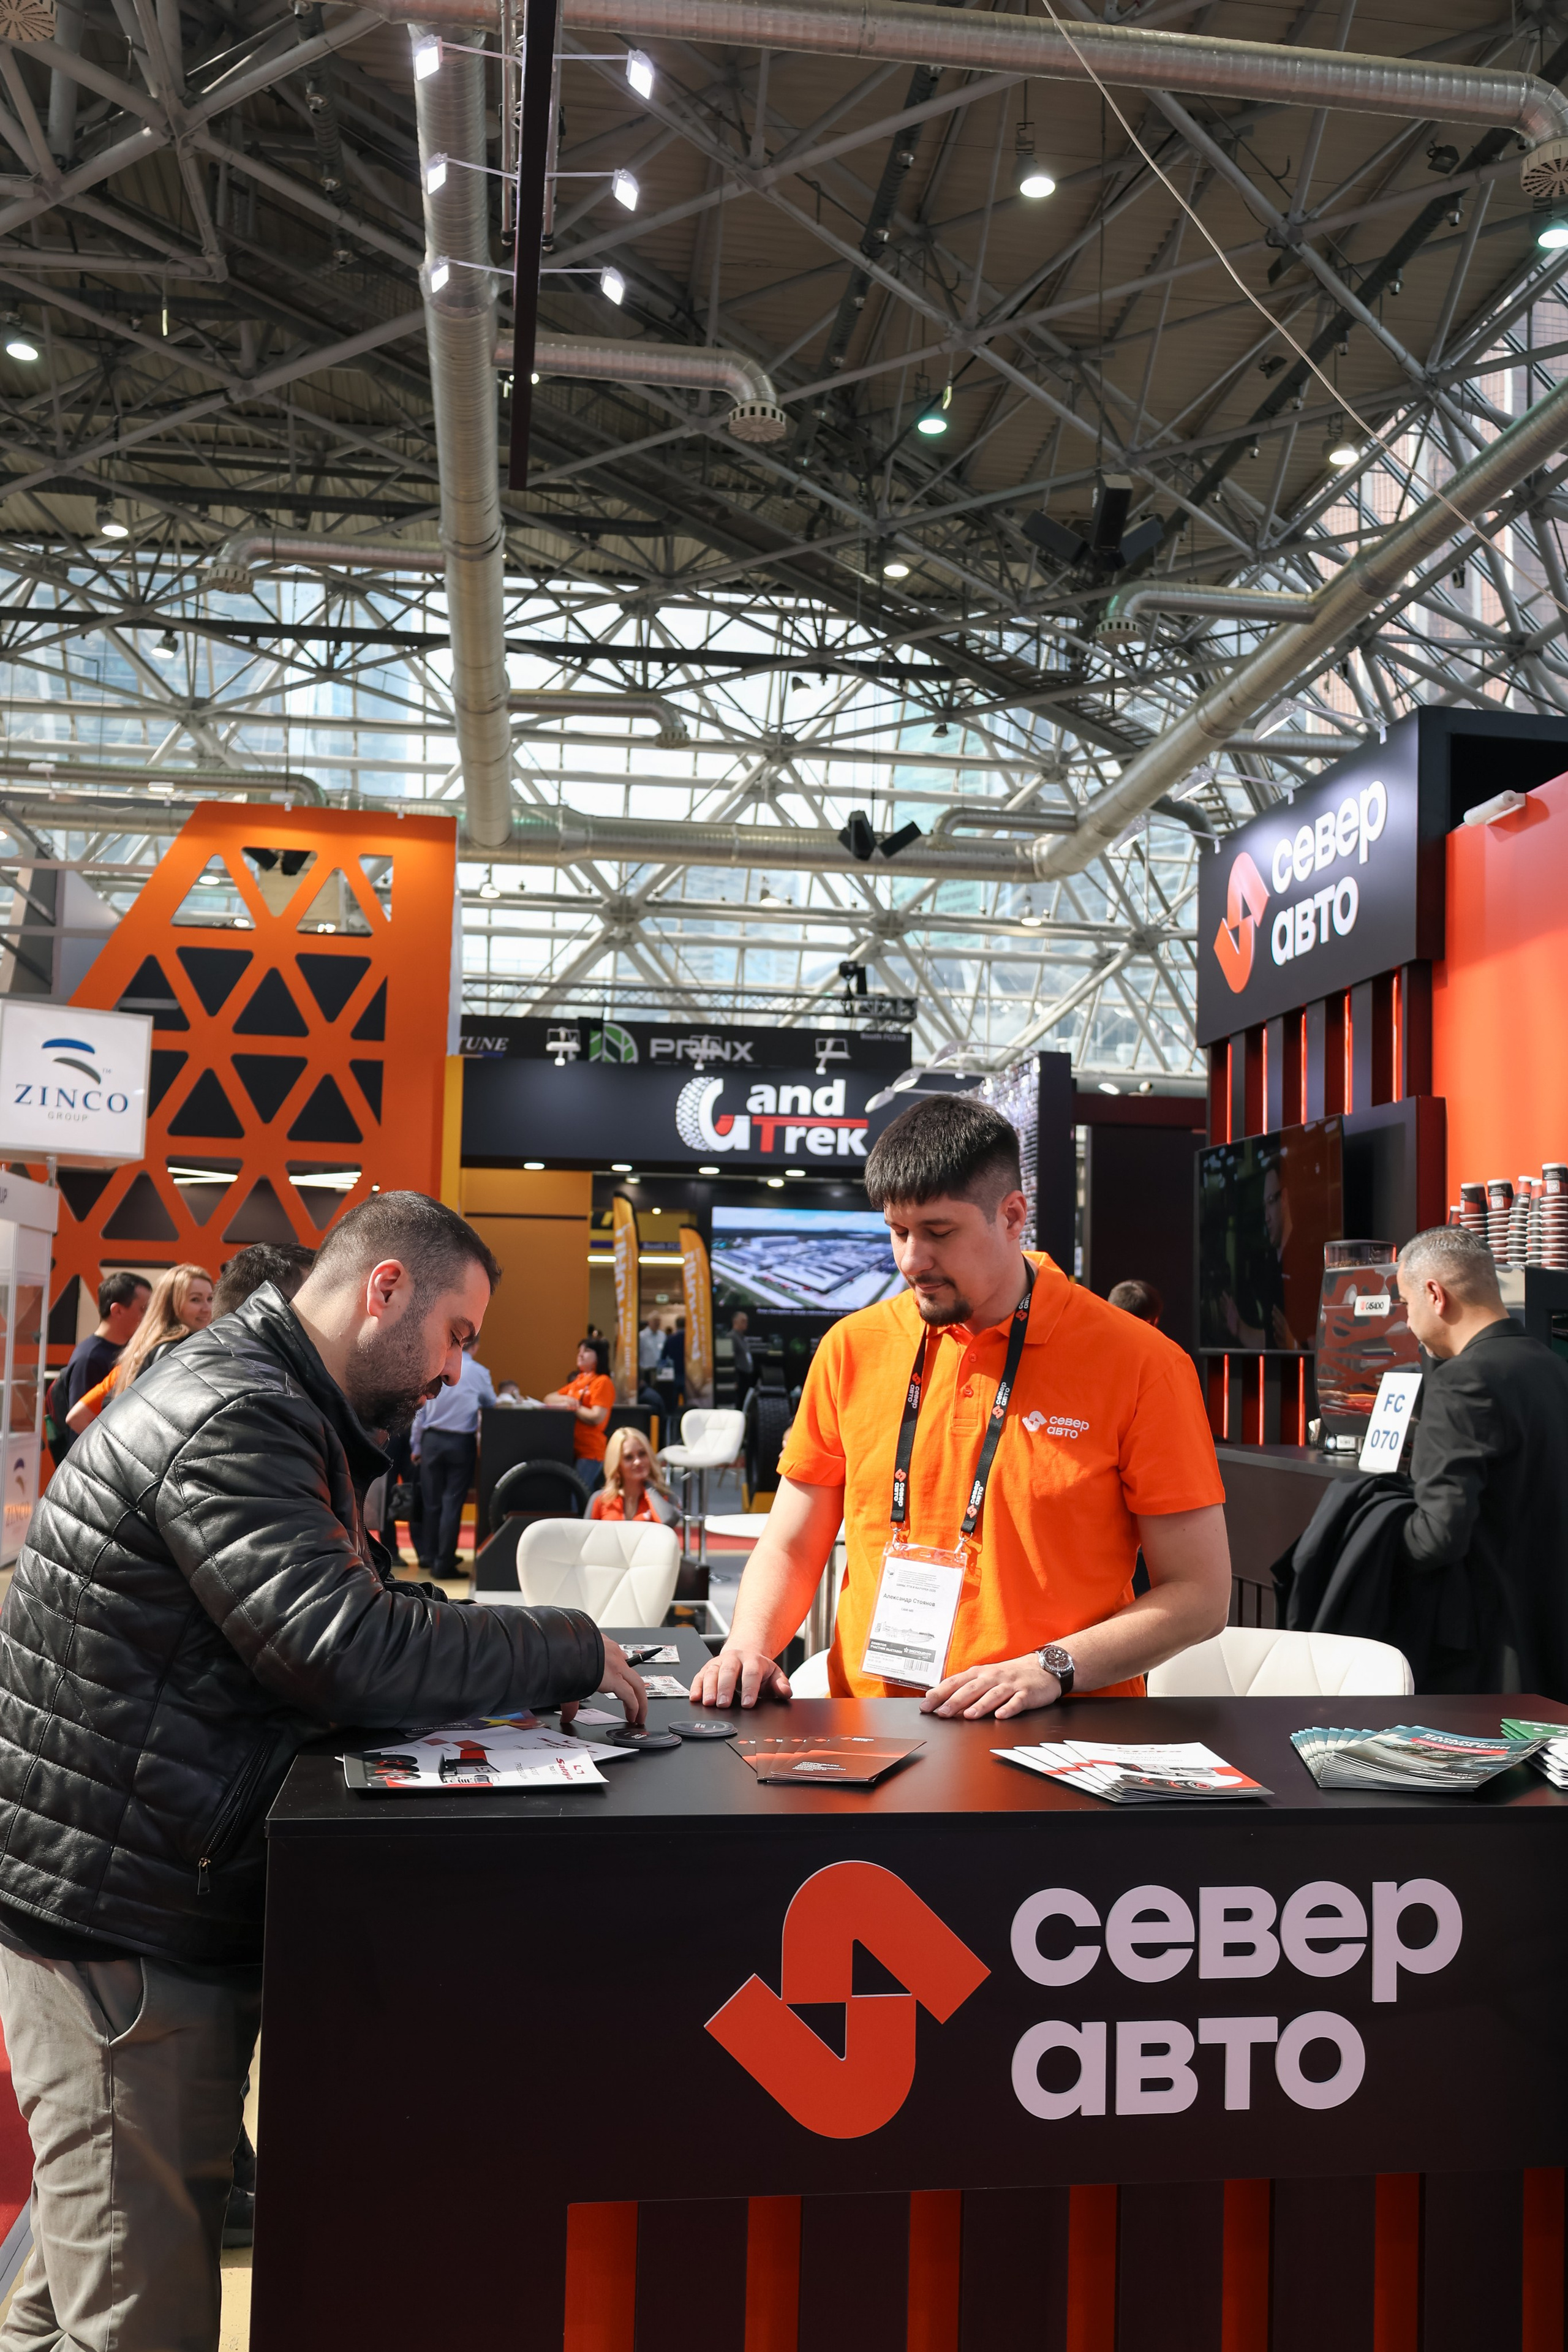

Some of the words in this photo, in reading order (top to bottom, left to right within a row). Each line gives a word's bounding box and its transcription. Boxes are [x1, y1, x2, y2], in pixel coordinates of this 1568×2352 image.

[1272, 781, 1387, 894] север
[1271, 876, 1359, 967] авто
[14, 1084, 129, 1114] ZINCO
[48, 1112, 88, 1121] GROUP
[995, 1382, 1007, 1406] север
[1001, 1387, 1011, 1406] авто
[1384, 1393, 1406, 1413] FC
[1047, 1426, 1078, 1439] авто
[1049, 1416, 1090, 1432] север
[1371, 1429, 1400, 1450] 070
[970, 1480, 981, 1504] север
[975, 1486, 984, 1506] авто
[883, 1593, 912, 1604] Александр
[913, 1598, 936, 1607] Стоянов
[556, 1757, 573, 1780] Satoya
[1010, 1878, 1463, 2003] север
[1011, 2010, 1366, 2120] авто
